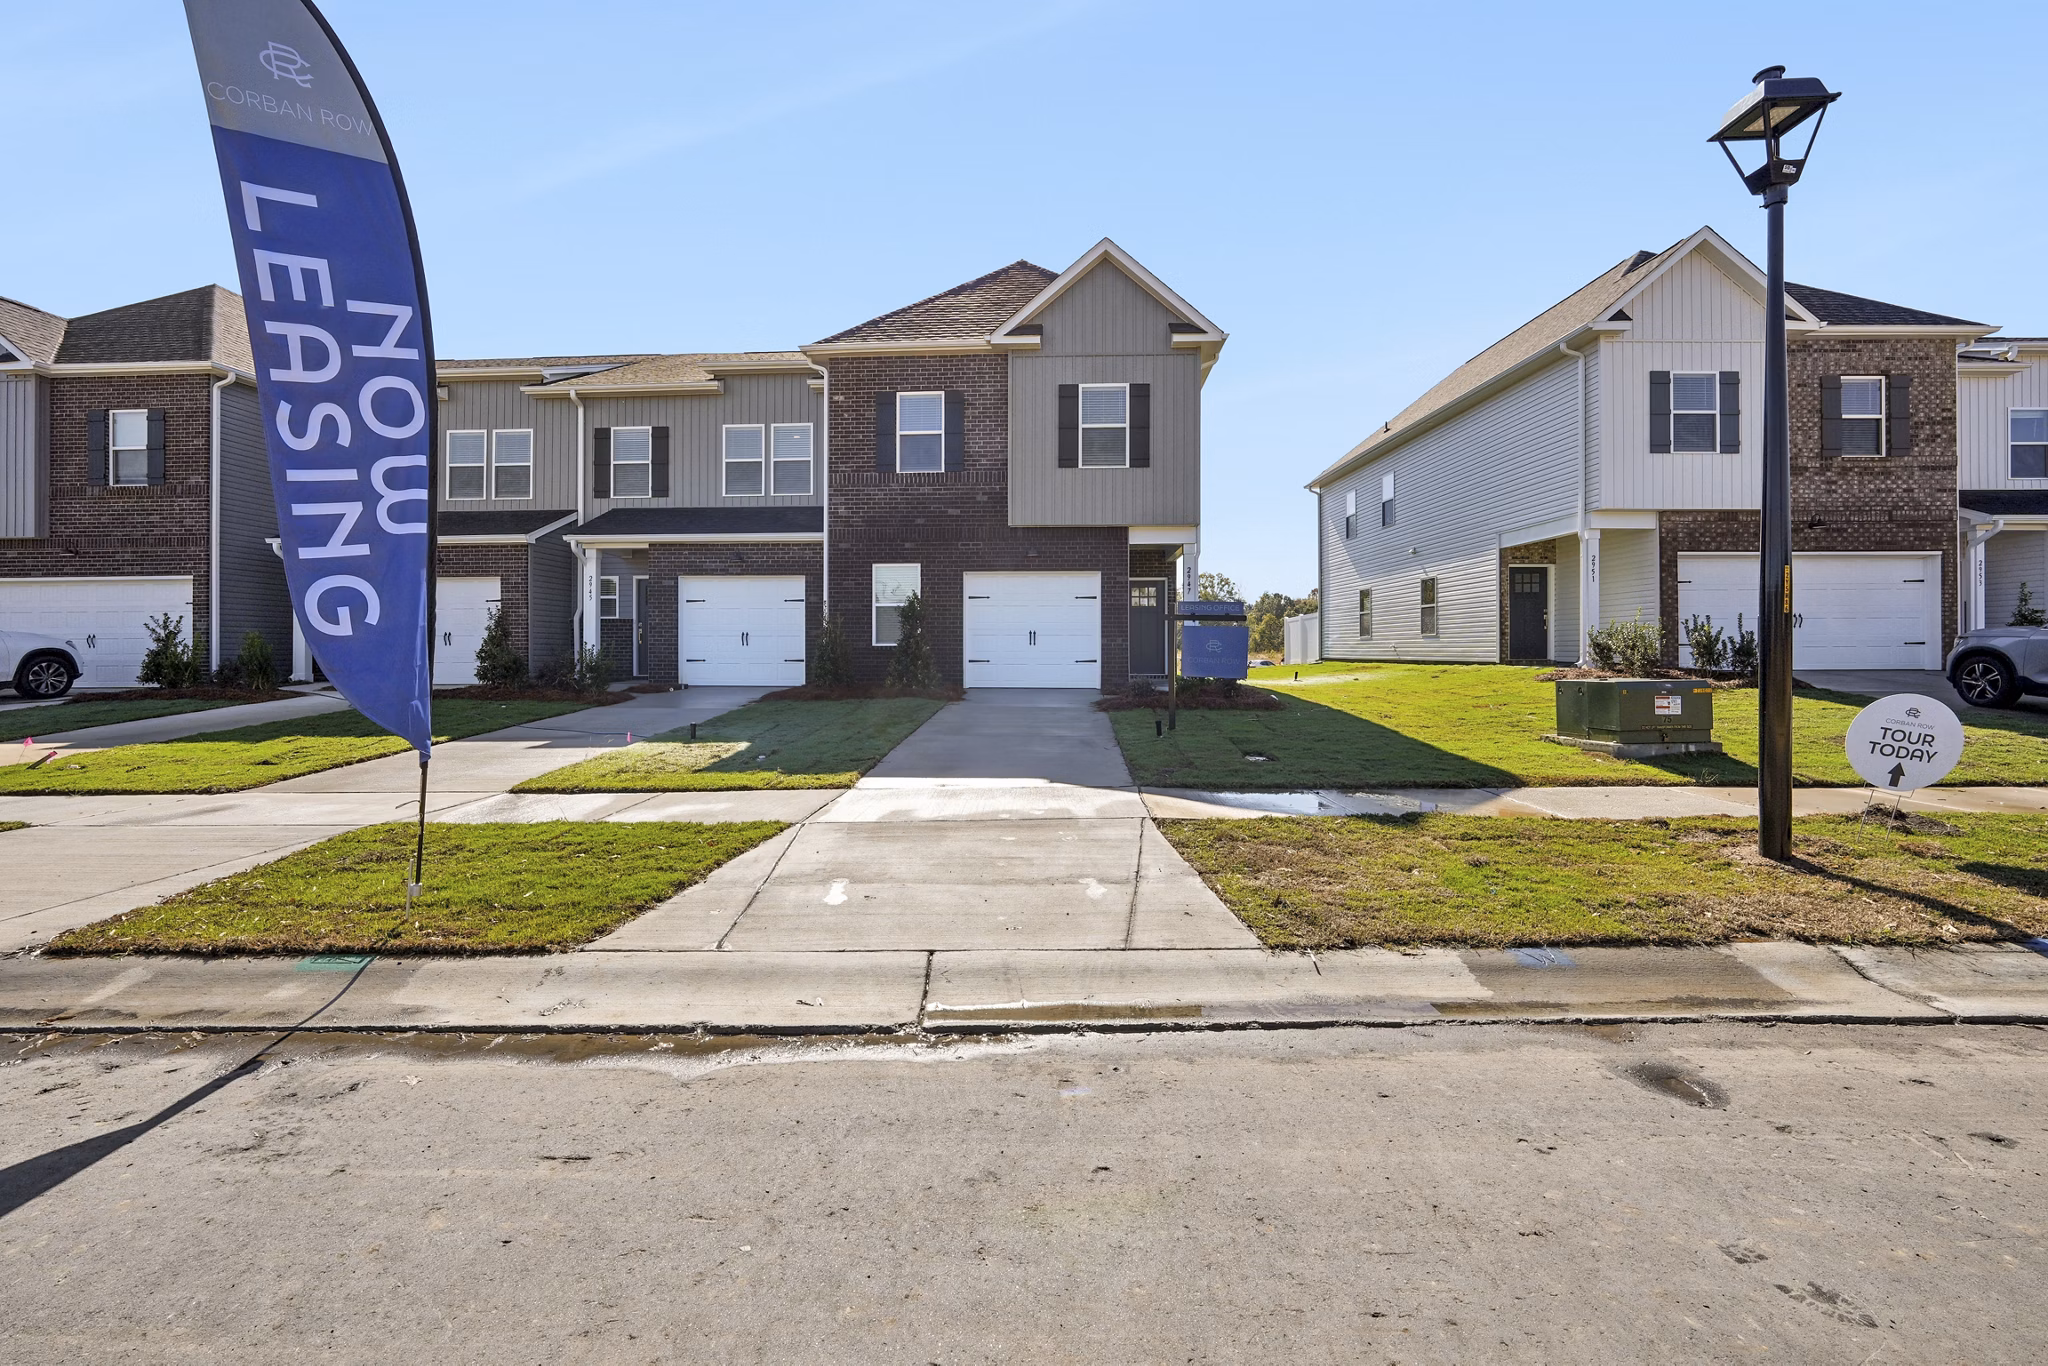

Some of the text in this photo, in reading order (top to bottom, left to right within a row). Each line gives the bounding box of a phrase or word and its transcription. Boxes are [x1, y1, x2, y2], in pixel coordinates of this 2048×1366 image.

[206, 81, 374, 137] CORBAN ROW
[239, 180, 381, 637] LEASING
[345, 299, 429, 535] NOW
[1213, 604, 1240, 612] OFFICE
[1188, 656, 1241, 665] CORBAN ROW
[1885, 717, 1935, 731] CORBAN ROW
[1880, 726, 1935, 748] TOUR
[1869, 741, 1938, 764] TODAY
